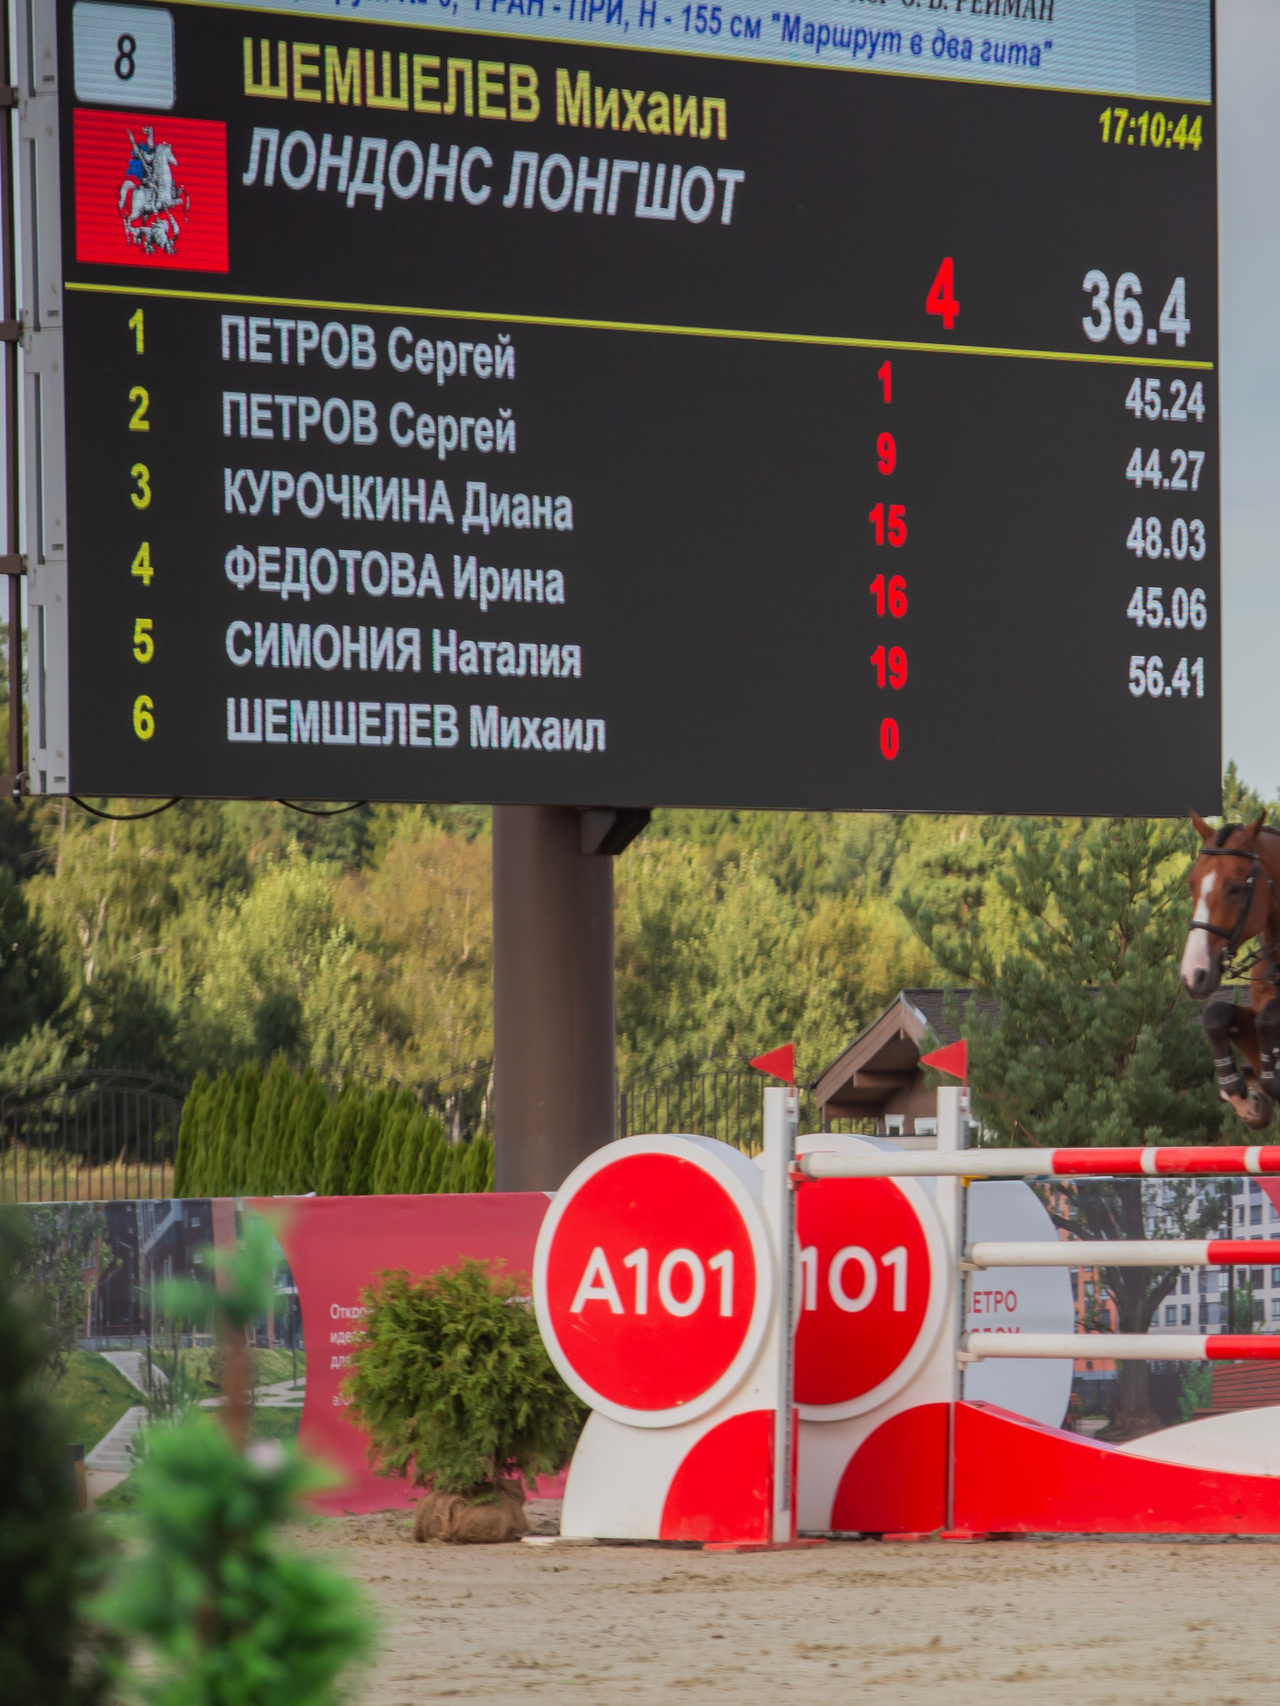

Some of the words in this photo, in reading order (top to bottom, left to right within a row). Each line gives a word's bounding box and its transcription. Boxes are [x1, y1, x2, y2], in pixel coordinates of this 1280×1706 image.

[114, 33, 136, 80] 8
[681, 4, 723, 35] 155
[730, 15, 762, 39] см
[772, 12, 902, 59] "Маршрут
[932, 27, 972, 60] два
[244, 38, 540, 121] ШЕМШЕЛЕВ
[556, 69, 726, 140] Михаил
[1100, 108, 1202, 150] 17:10:44
[243, 128, 492, 210] ЛОНДОНС
[503, 151, 745, 224] ЛОНГШОТ
[926, 257, 959, 329] 4
[1083, 270, 1191, 346] 36.4
[129, 309, 144, 352] 1
[222, 315, 376, 368] ПЕТРОВ
[388, 327, 515, 385] Сергей
[878, 361, 891, 403] 1
[1125, 378, 1205, 422] 45.24
[129, 386, 149, 430] 2
[223, 392, 378, 444] ПЕТРОВ
[390, 402, 516, 459] Сергей
[877, 432, 896, 475] 9
[1126, 448, 1205, 490] 44.27
[131, 464, 151, 508] 3
[225, 468, 454, 524] КУРОЧКИНА
[462, 482, 573, 534] Диана
[869, 503, 907, 547] 15
[1126, 517, 1206, 560] 48.03
[131, 542, 153, 584] 4
[225, 545, 444, 601] ФЕДОТОВА
[454, 555, 565, 612] Ирина
[870, 574, 908, 618] 16
[1127, 587, 1207, 630] 45.06
[133, 619, 154, 662] 5
[226, 621, 420, 672] СИМОНИЯ
[433, 629, 581, 678] Наталия
[870, 645, 907, 689] 19
[1129, 656, 1204, 698] 56.41
[133, 695, 154, 739] 6
[227, 698, 458, 746] ШЕМШЕЛЕВ
[470, 705, 605, 751] Михаил
[880, 718, 899, 760] 0
[569, 1246, 734, 1317] A101
[801, 1245, 908, 1312] 101
[967, 1290, 1017, 1313] ЕТРО
